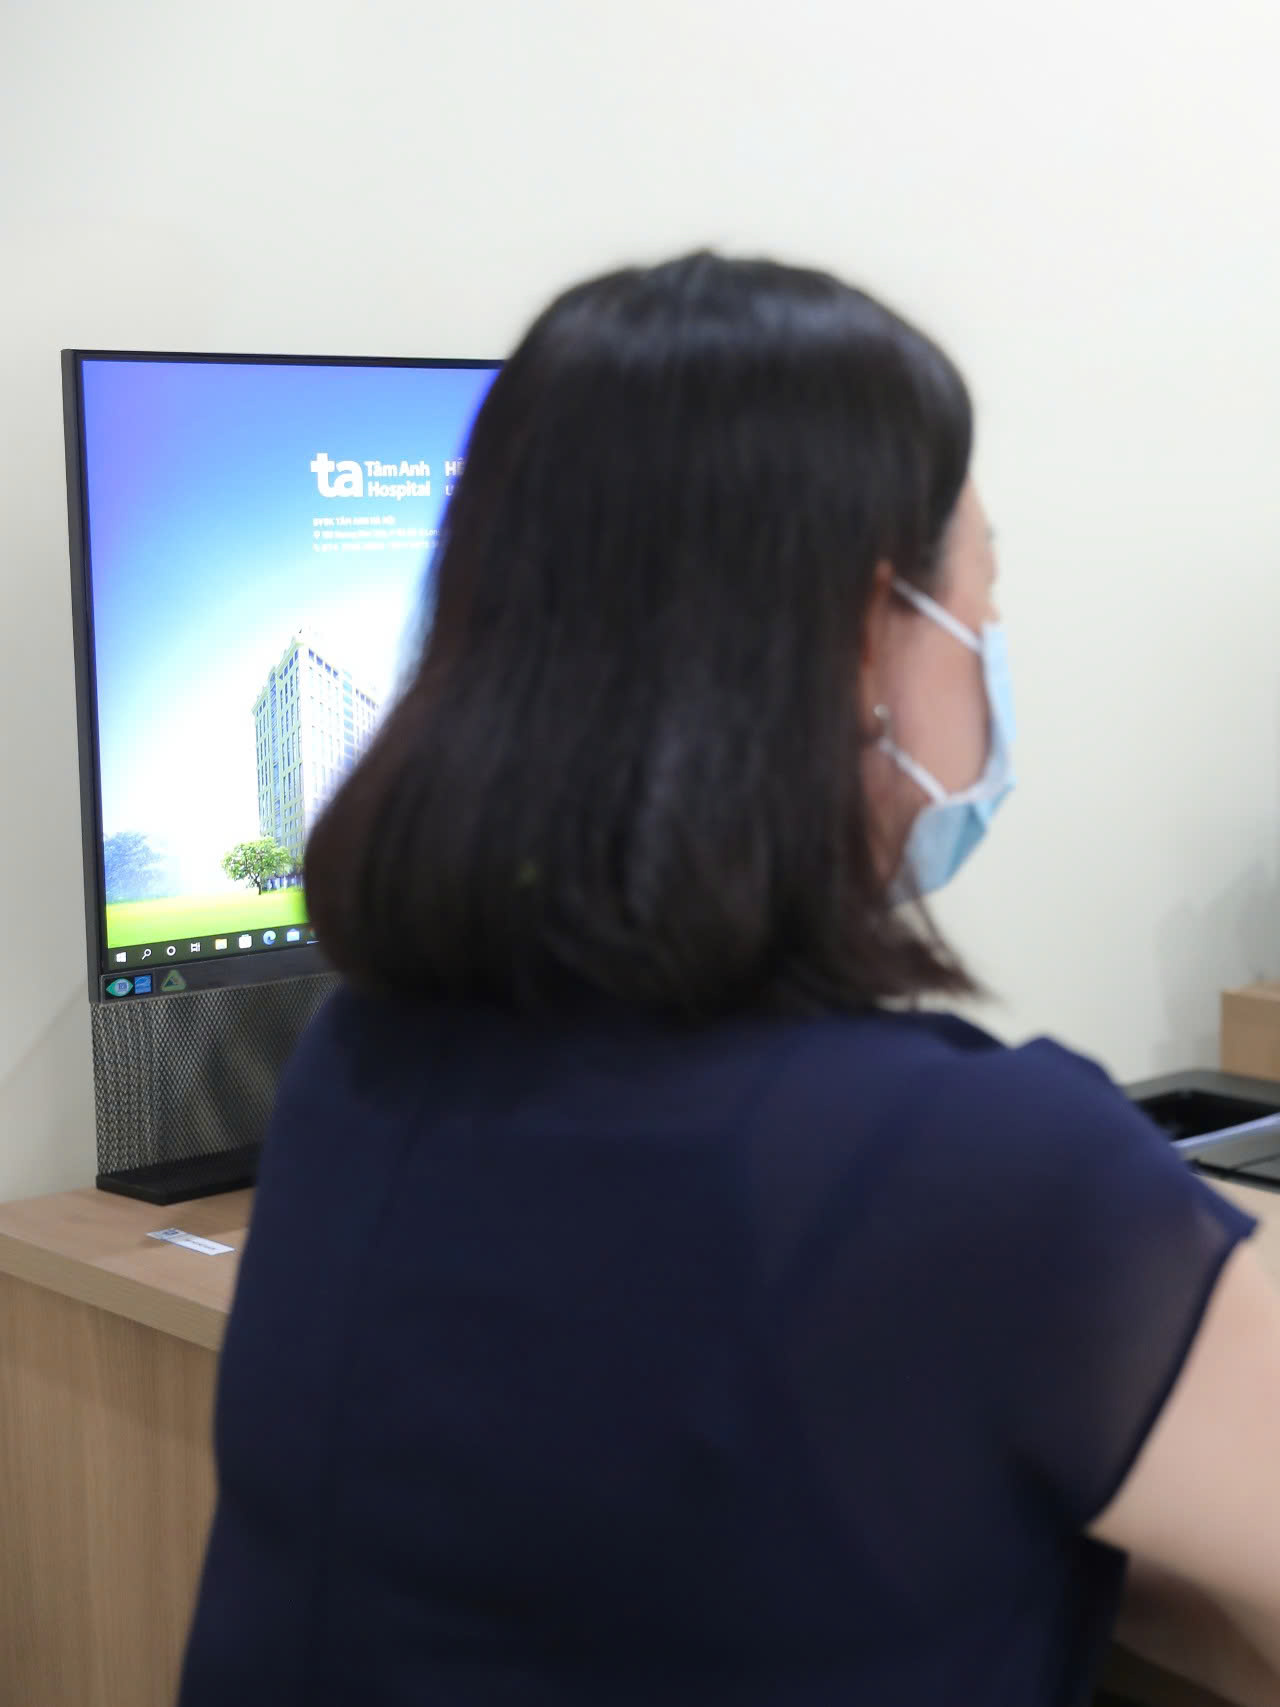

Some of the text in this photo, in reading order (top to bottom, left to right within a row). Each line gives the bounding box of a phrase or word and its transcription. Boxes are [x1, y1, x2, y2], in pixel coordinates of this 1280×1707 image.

[310, 453, 363, 497] ta
[400, 460, 430, 476] Anh
[368, 481, 431, 500] Hospital
